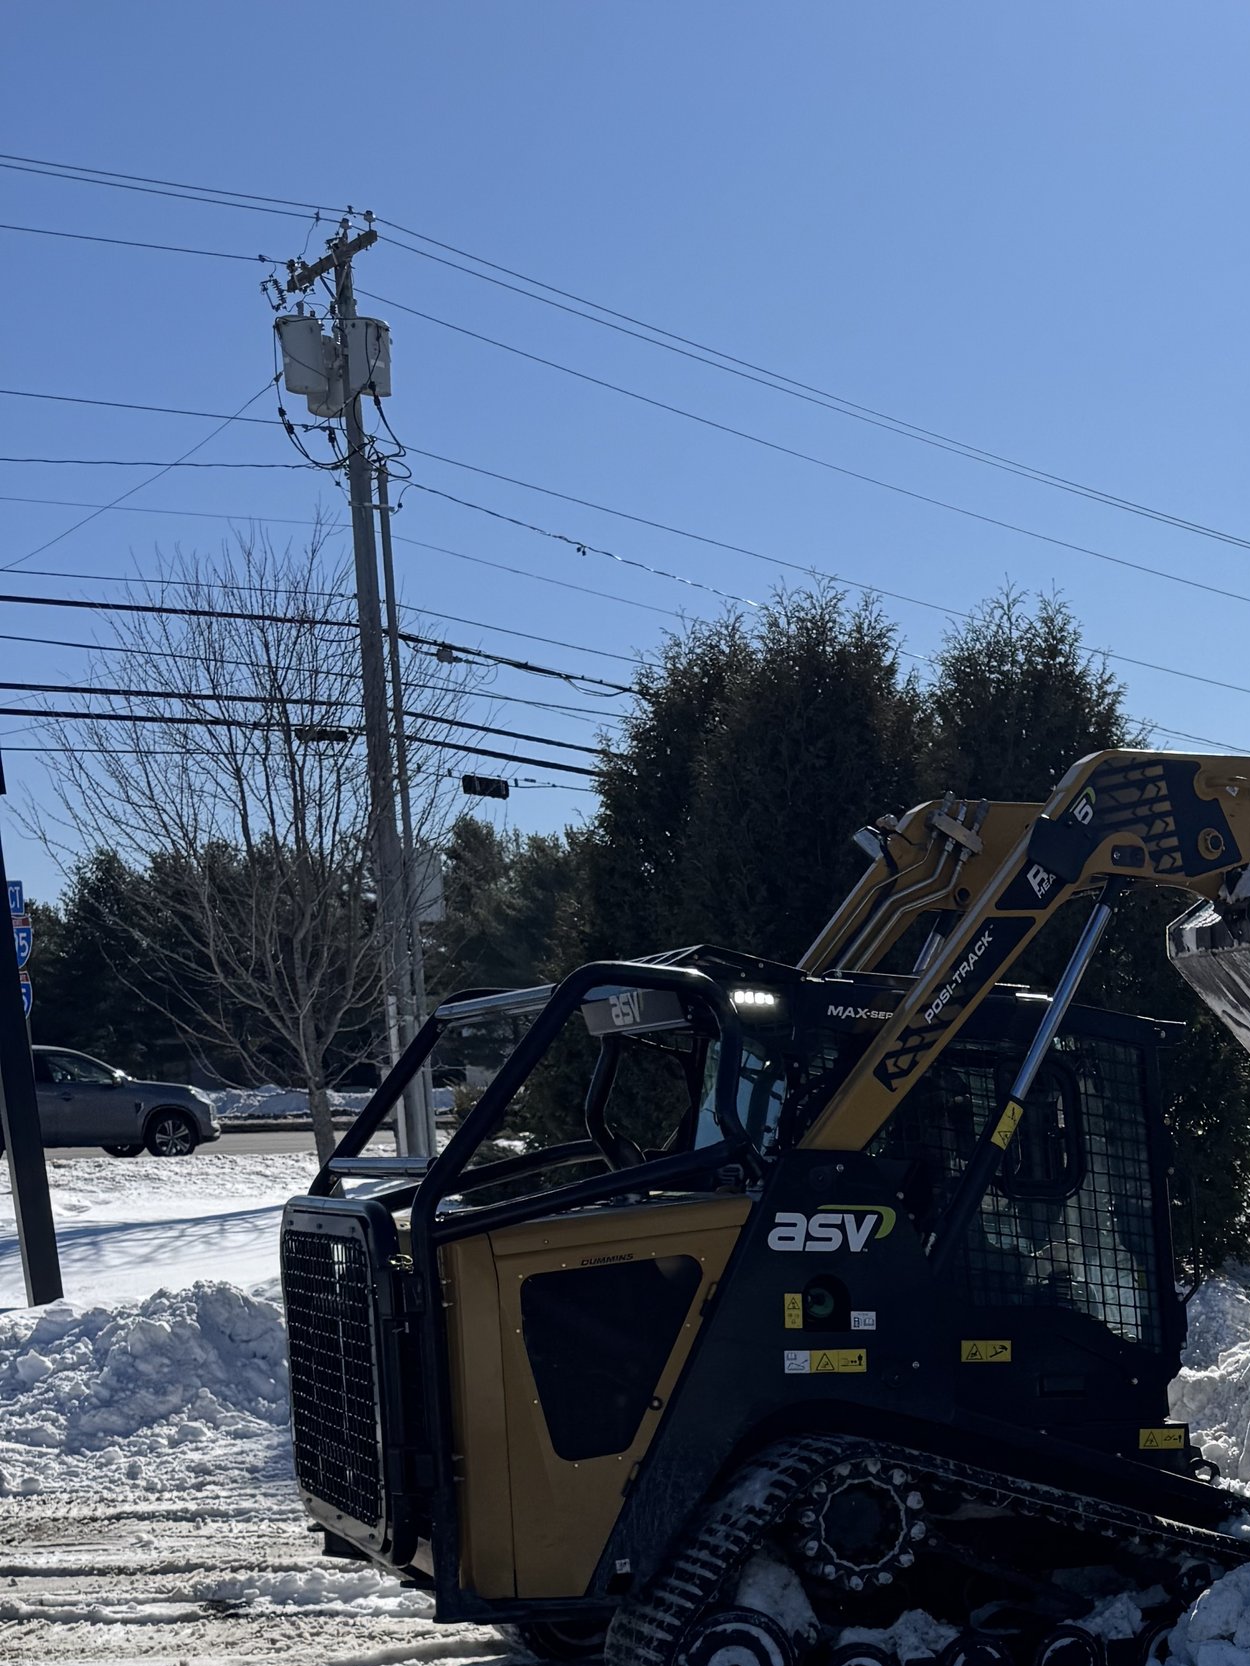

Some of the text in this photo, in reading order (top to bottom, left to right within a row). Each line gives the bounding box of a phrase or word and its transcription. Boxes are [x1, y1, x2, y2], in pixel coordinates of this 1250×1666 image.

[8, 886, 20, 909] CT
[1034, 874, 1056, 899] HEA
[924, 930, 993, 1024] POSI-TRACK
[827, 1004, 894, 1020] MAX-SER
